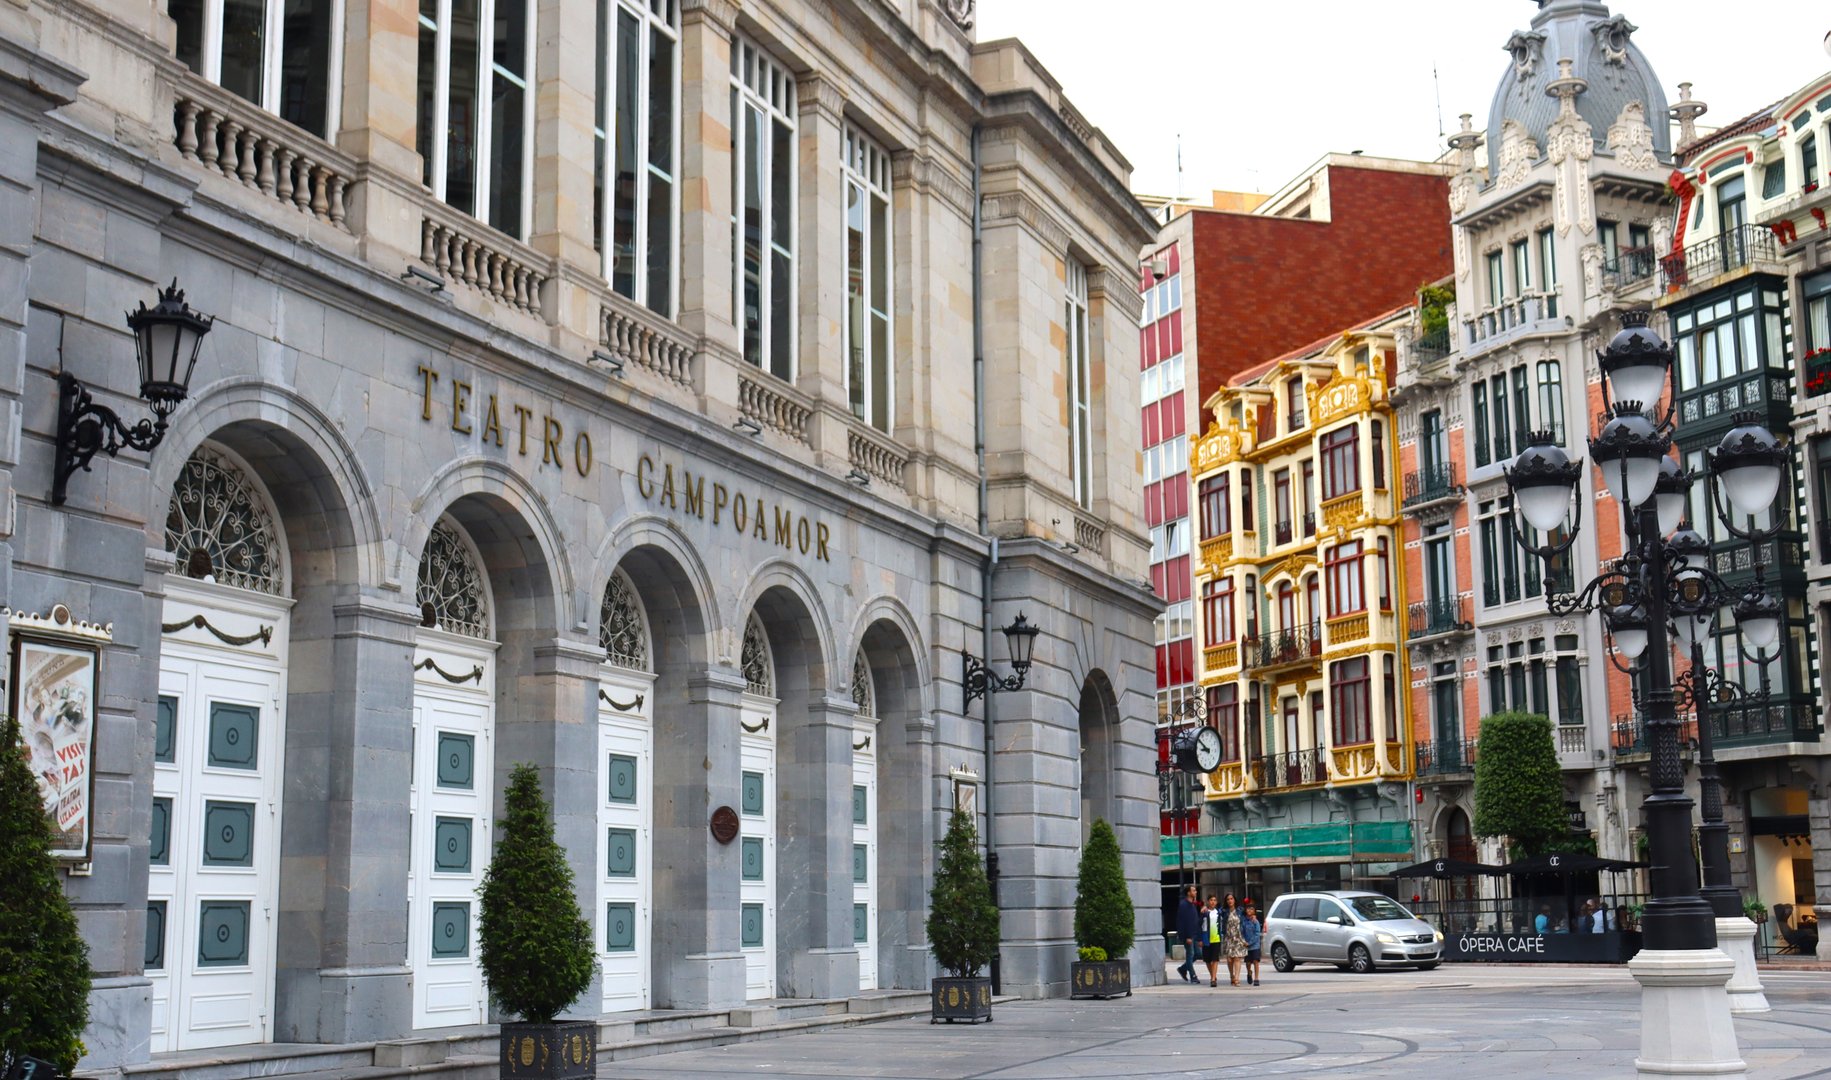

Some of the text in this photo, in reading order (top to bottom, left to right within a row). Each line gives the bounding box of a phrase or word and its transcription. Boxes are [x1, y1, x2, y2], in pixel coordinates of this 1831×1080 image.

[418, 366, 831, 562] TEATRO CAMPOAMOR
[1460, 934, 1545, 952] ÓPERA CAFÉ
